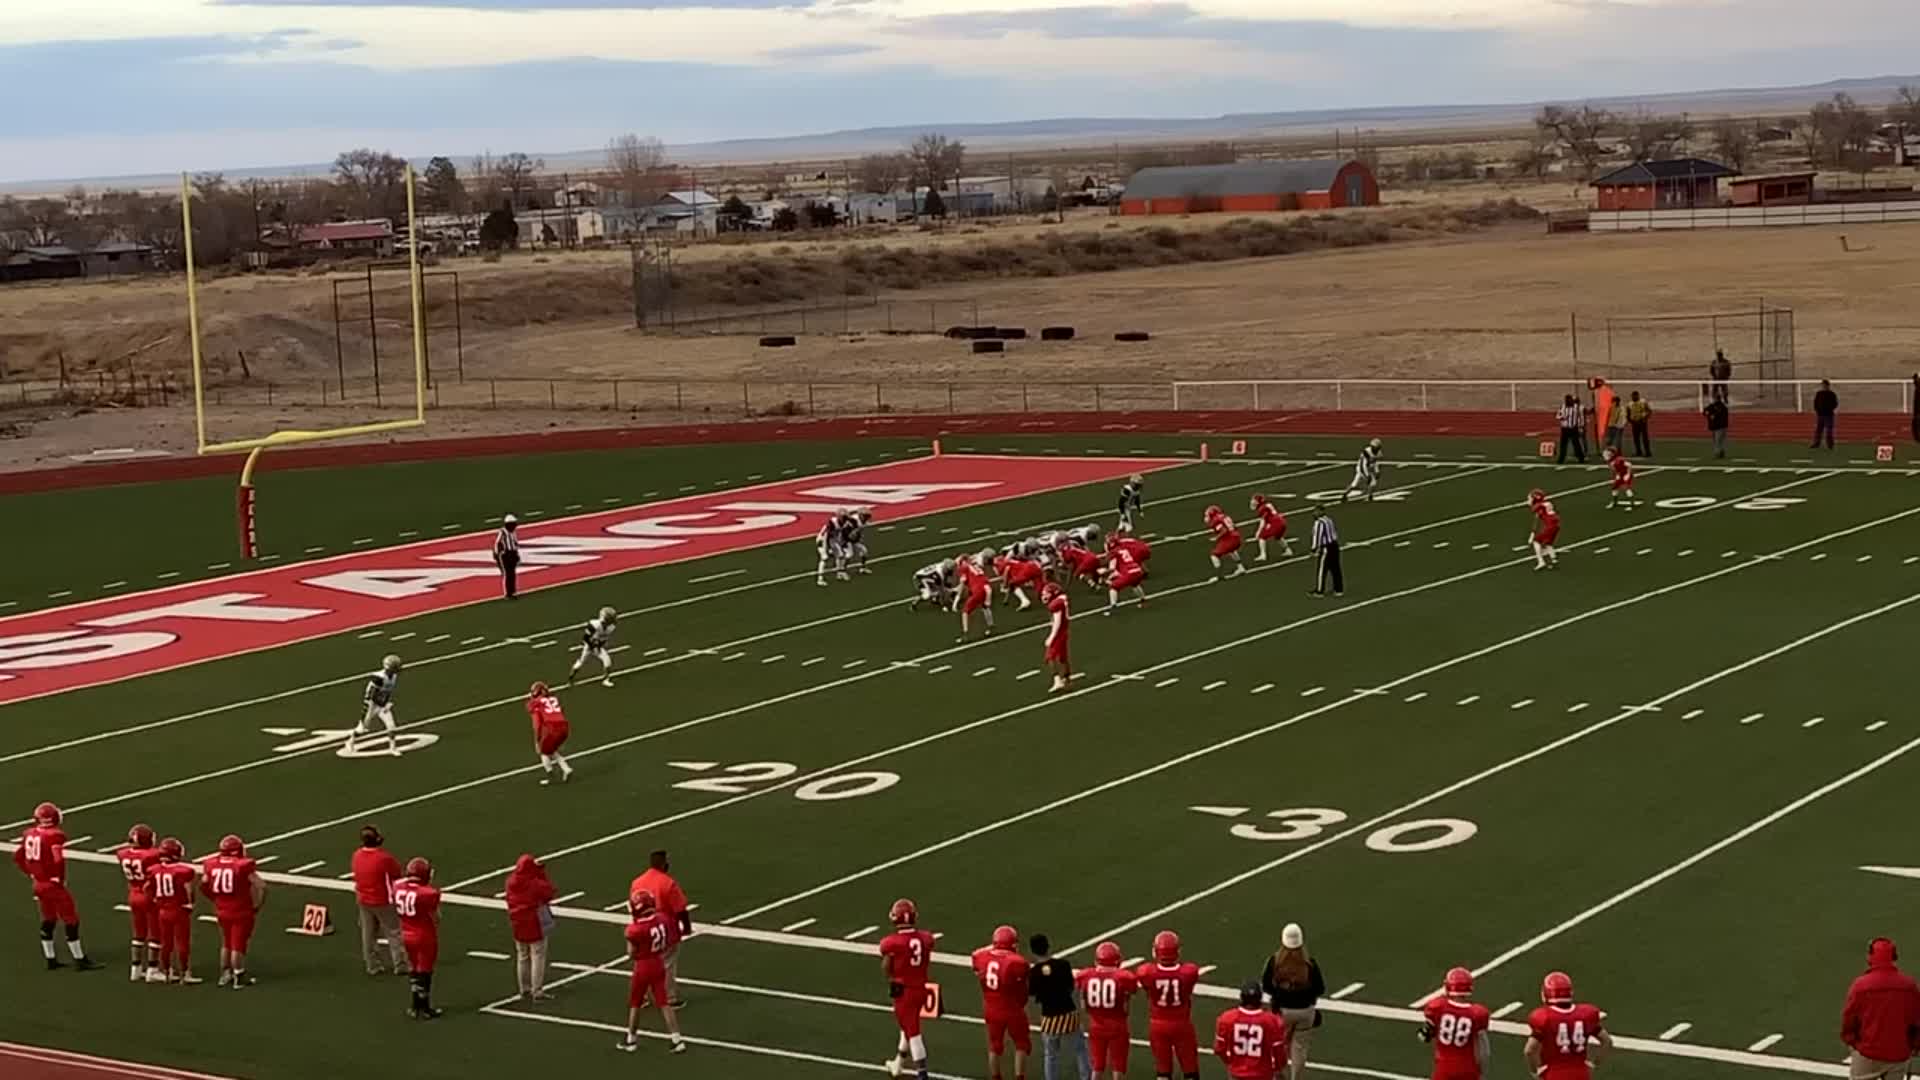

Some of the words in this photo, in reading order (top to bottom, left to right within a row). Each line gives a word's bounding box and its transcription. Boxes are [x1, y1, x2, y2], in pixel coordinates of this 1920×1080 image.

[0, 481, 1005, 681] STANCIA
[540, 697, 562, 714] 32
[671, 762, 901, 800] 20
[1230, 808, 1478, 852] 30
[155, 872, 175, 898] 10
[211, 868, 234, 894] 70
[395, 889, 417, 917] 50
[306, 907, 323, 932] 20
[650, 922, 667, 953] 21
[909, 937, 922, 967] 3
[986, 961, 999, 990] 6
[1087, 977, 1116, 1009] 80
[1155, 979, 1182, 1007] 71
[1233, 1023, 1264, 1057] 52
[1438, 1014, 1473, 1048] 88
[1556, 1020, 1586, 1054] 44
